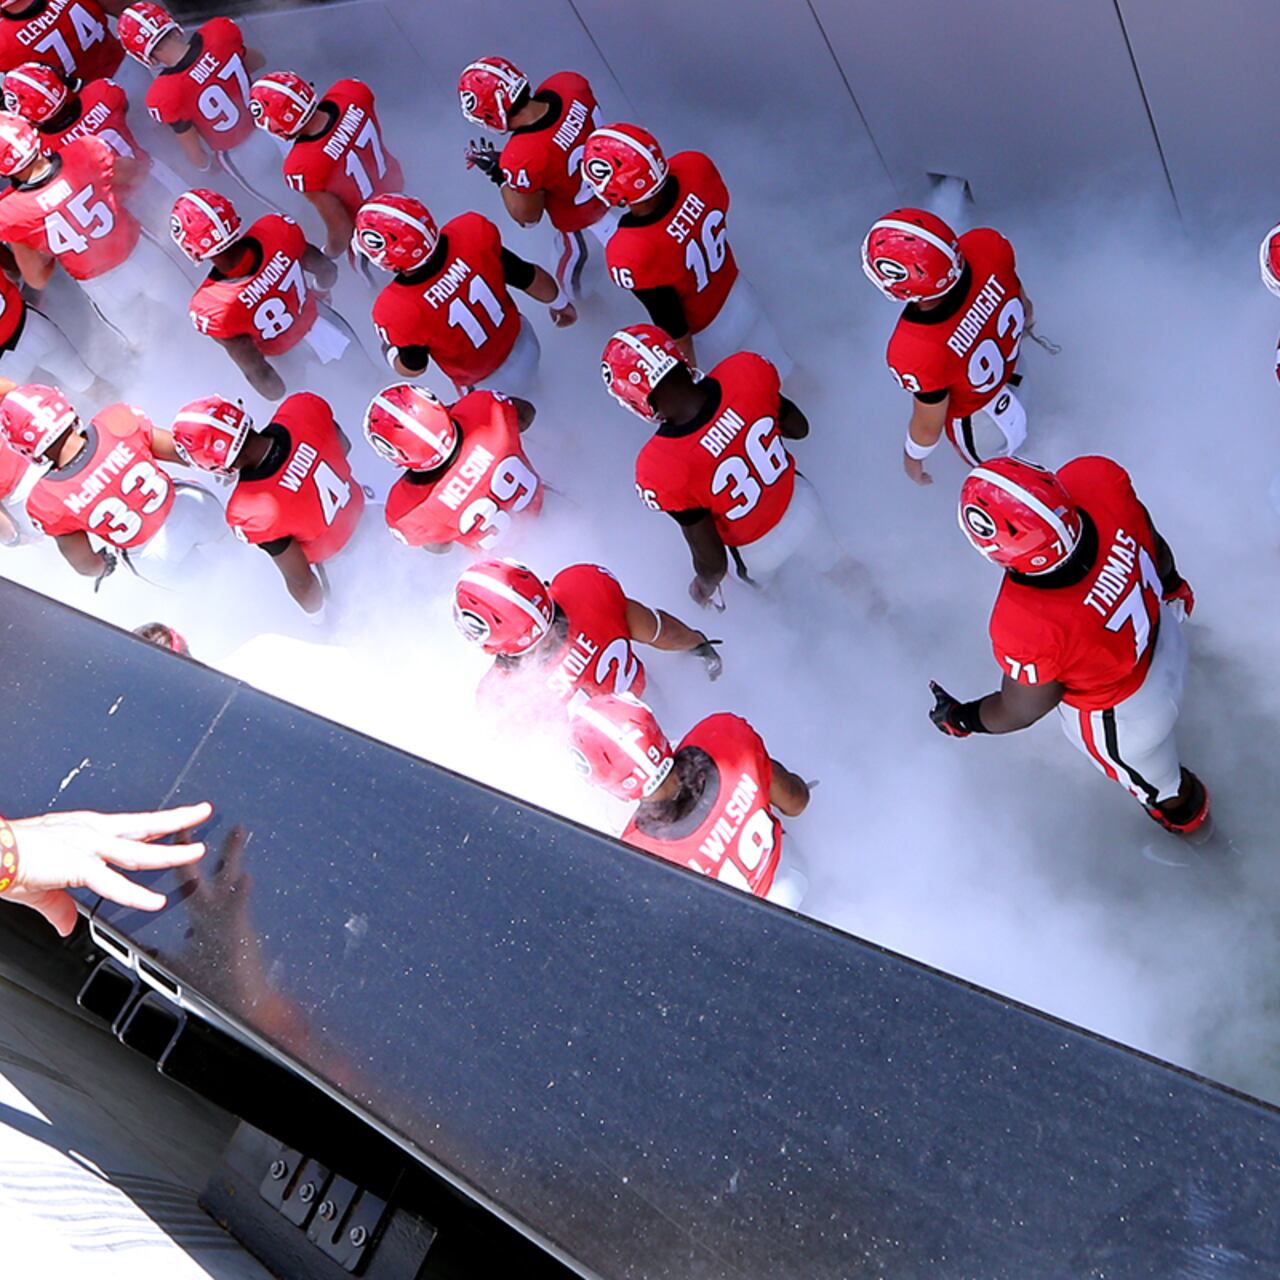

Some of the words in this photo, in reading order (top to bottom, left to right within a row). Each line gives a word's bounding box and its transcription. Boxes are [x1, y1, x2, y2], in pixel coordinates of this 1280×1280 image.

[34, 3, 106, 77] 74
[189, 52, 221, 85] BUCE
[198, 53, 251, 132] 97
[323, 103, 365, 161] DOWNING
[552, 99, 589, 151] HUDSON
[286, 174, 305, 192] 17
[346, 118, 388, 199] 17
[502, 169, 531, 189] 24
[589, 160, 612, 179] G
[44, 184, 114, 255] 45
[361, 231, 385, 250] G
[666, 193, 706, 244] SETER
[237, 251, 292, 309] SIMMONS
[611, 266, 635, 289] 16
[685, 209, 726, 293] 16
[877, 260, 907, 280] G
[253, 259, 307, 341] 87
[423, 258, 472, 309] FROMM
[448, 274, 506, 349] 11
[947, 274, 1006, 358] RUBRIGHT
[637, 345, 667, 375] 36
[699, 407, 746, 458] BRINI
[63, 441, 135, 514] McINTYRE
[278, 442, 318, 492] WOOD
[313, 460, 352, 526] 4
[438, 444, 495, 510] NELSON
[711, 416, 789, 521] 36
[88, 461, 169, 544] 33
[459, 455, 538, 550] 39
[966, 507, 995, 537] G
[1083, 529, 1138, 616] THOMAS
[1105, 545, 1163, 665] 71
[546, 632, 599, 696] SKOLE
[1005, 656, 1038, 684] 71
[636, 747, 660, 780] 19
[699, 773, 759, 856] WILSON
[718, 808, 774, 894] 19
